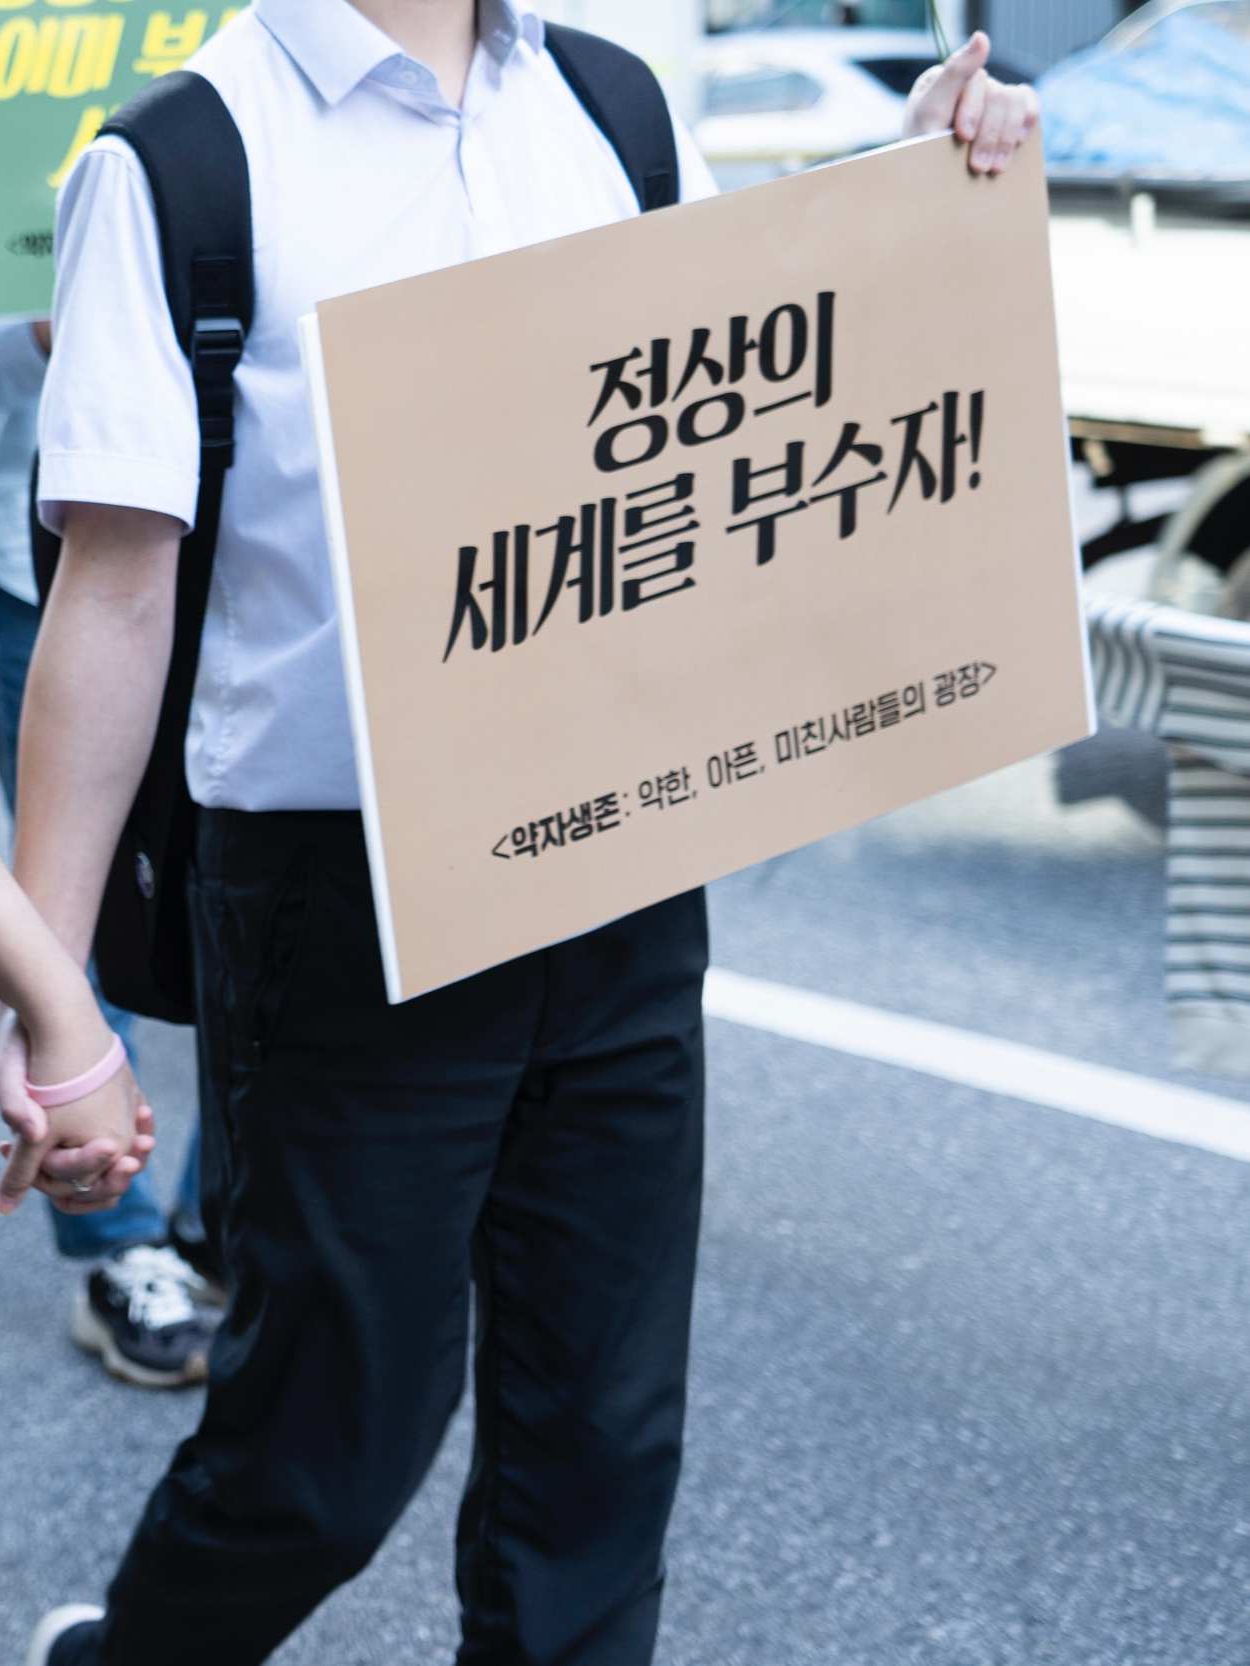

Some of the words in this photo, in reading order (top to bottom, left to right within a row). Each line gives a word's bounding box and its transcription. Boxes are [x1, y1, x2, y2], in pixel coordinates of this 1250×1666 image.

[587, 291, 835, 473] 정상의
[442, 472, 701, 664] 세계를
[725, 389, 984, 566] 부수자!
[637, 767, 698, 811] 약한,
[707, 741, 766, 789] 아픈,
[774, 682, 926, 764] 미친사람들의
